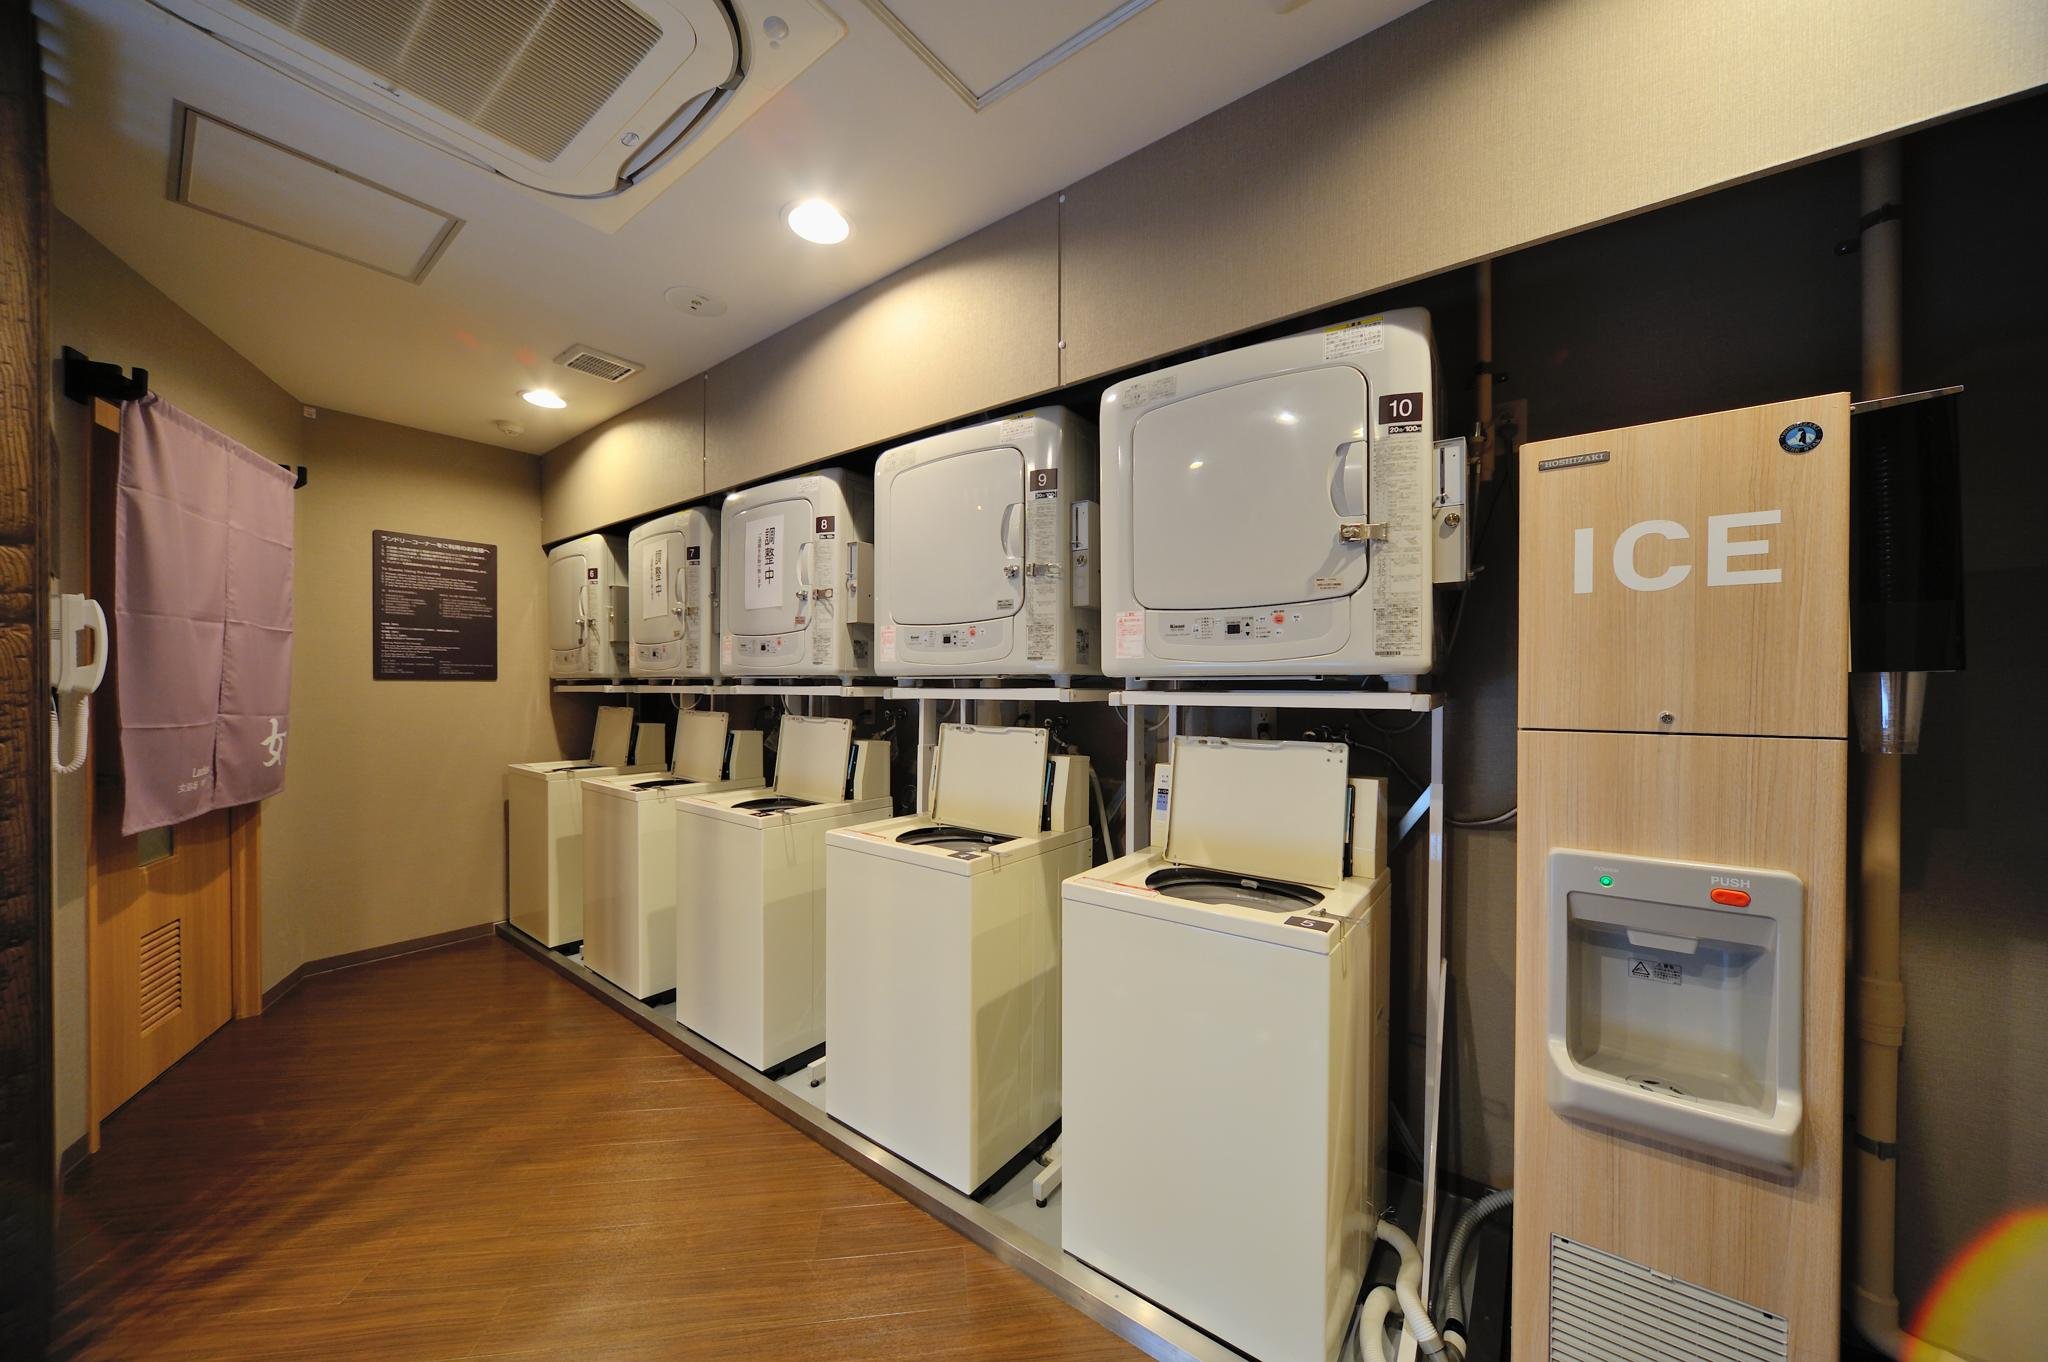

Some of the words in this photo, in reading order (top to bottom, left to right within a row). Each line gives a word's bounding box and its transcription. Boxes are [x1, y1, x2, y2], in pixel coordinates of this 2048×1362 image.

[1389, 399, 1413, 417] 10
[1545, 453, 1604, 468] HOSHIZAKI
[1038, 474, 1047, 487] 9
[821, 519, 828, 530] 8
[690, 548, 694, 558] 7
[1573, 509, 1783, 594] ICE
[590, 570, 594, 578] 6
[260, 718, 287, 768] 女
[1711, 875, 1751, 889] PUSH
